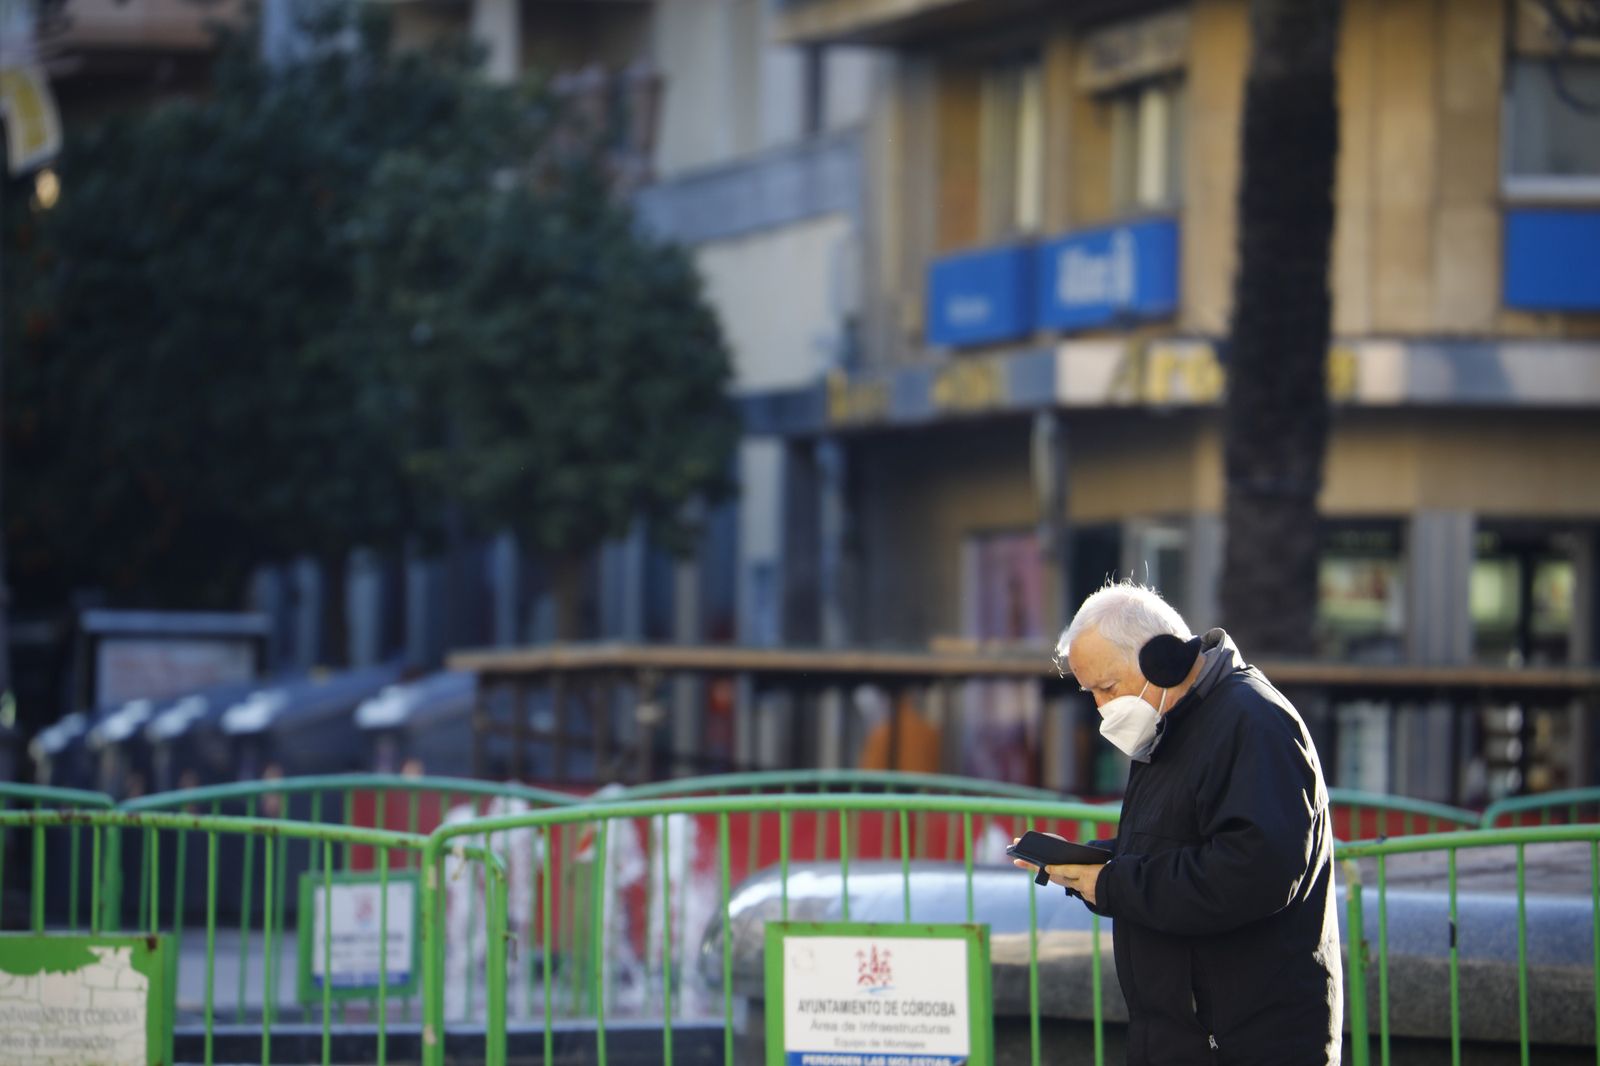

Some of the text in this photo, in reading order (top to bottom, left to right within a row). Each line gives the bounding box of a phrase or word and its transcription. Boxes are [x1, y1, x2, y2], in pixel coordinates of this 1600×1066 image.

[798, 998, 880, 1016] AYUNTAMIENTO
[883, 1000, 898, 1016] DE
[841, 1020, 856, 1032] de
[860, 1020, 951, 1035] Infraestructuras
[869, 1038, 881, 1048] de
[802, 1054, 862, 1066] PERDONEN
[864, 1055, 886, 1066] LAS
